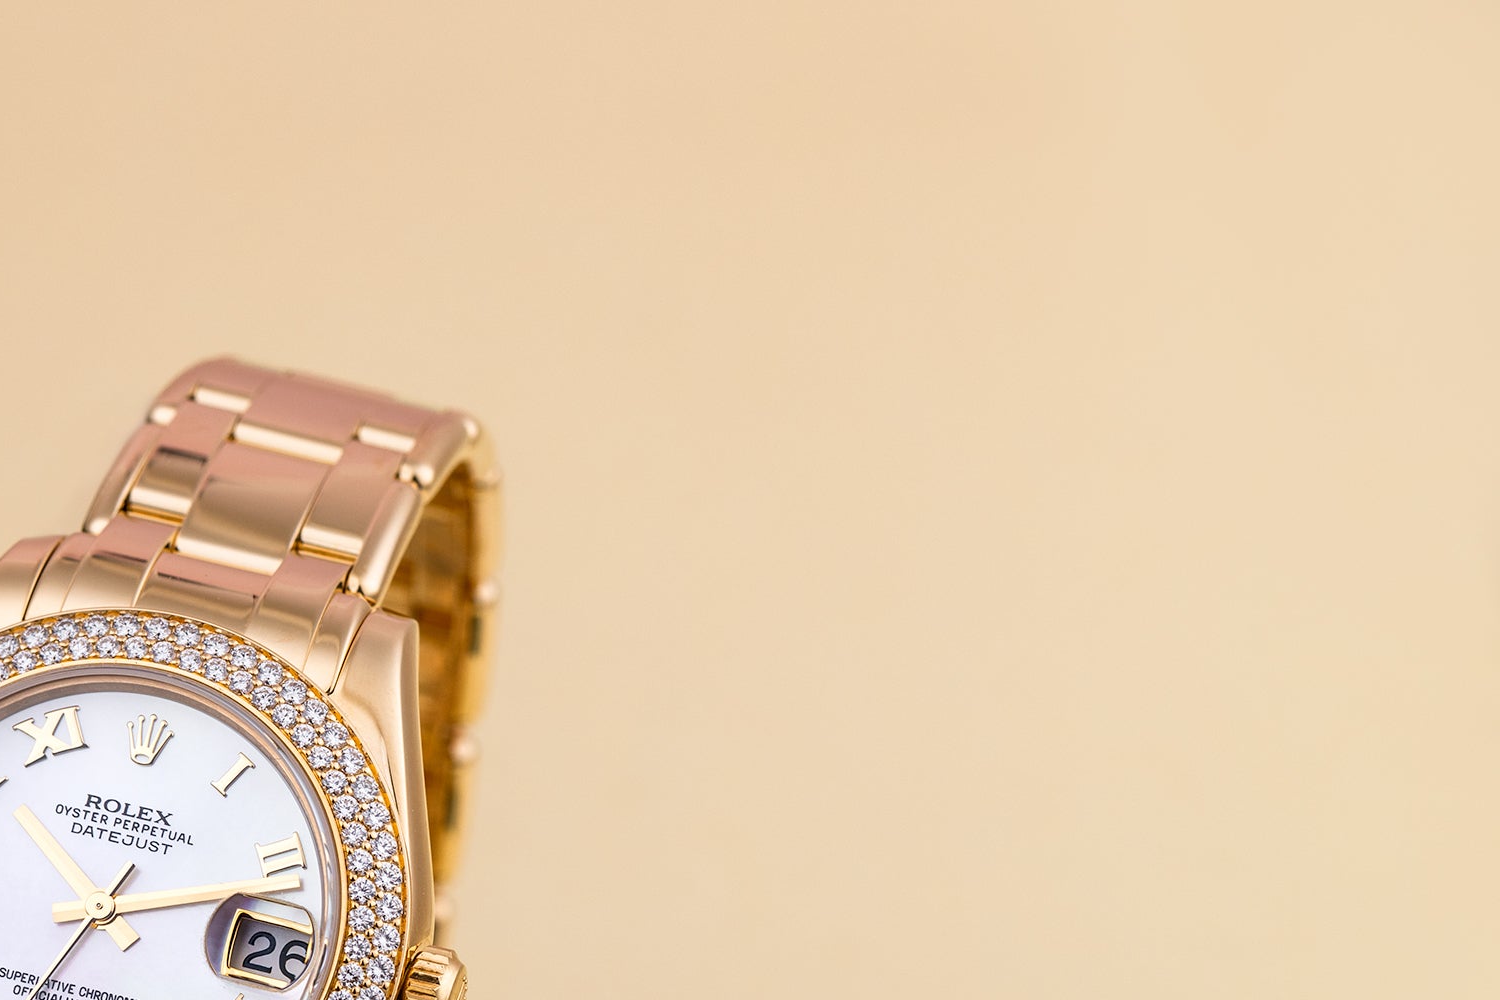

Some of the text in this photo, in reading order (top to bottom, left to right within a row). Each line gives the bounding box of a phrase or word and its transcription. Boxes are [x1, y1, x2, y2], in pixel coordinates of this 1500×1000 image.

[12, 705, 88, 767] XI
[210, 752, 256, 798] I
[55, 803, 195, 846] OYSTER PERPETUAL
[84, 793, 173, 827] ROLEX
[70, 822, 173, 855] DATEJUST
[242, 930, 309, 983] 26
